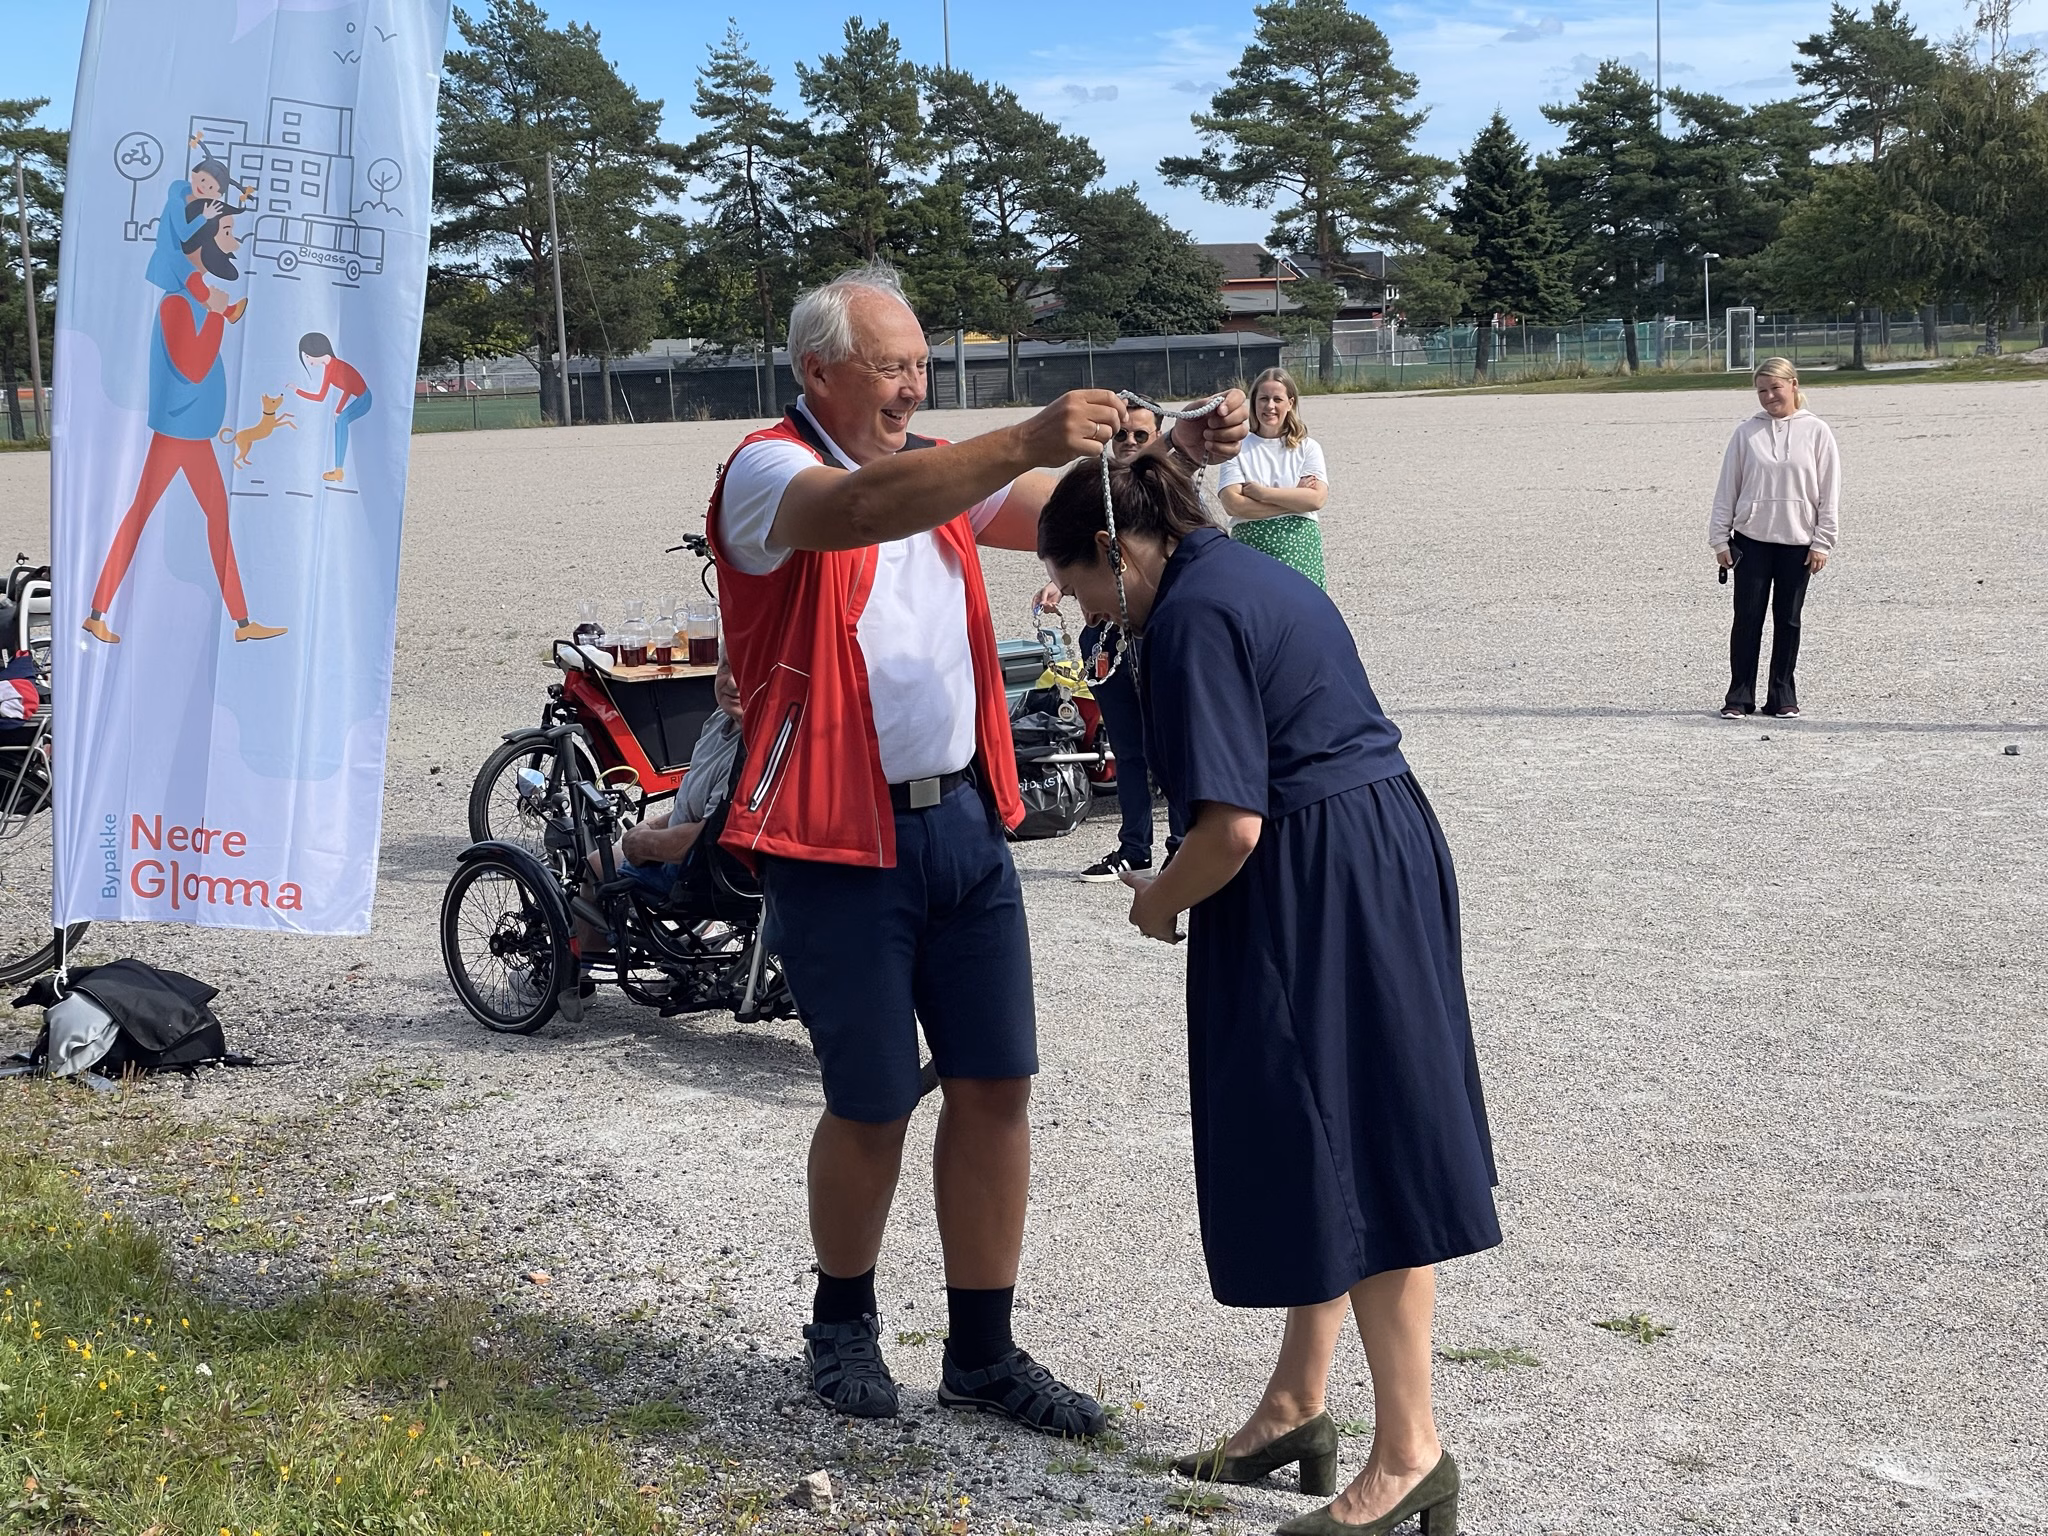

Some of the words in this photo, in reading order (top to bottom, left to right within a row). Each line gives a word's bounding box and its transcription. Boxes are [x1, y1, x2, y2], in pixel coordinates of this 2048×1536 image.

[299, 246, 346, 264] Biogass
[100, 813, 121, 899] Bypakke
[131, 814, 247, 858] Nedre
[131, 859, 304, 911] Glomma
